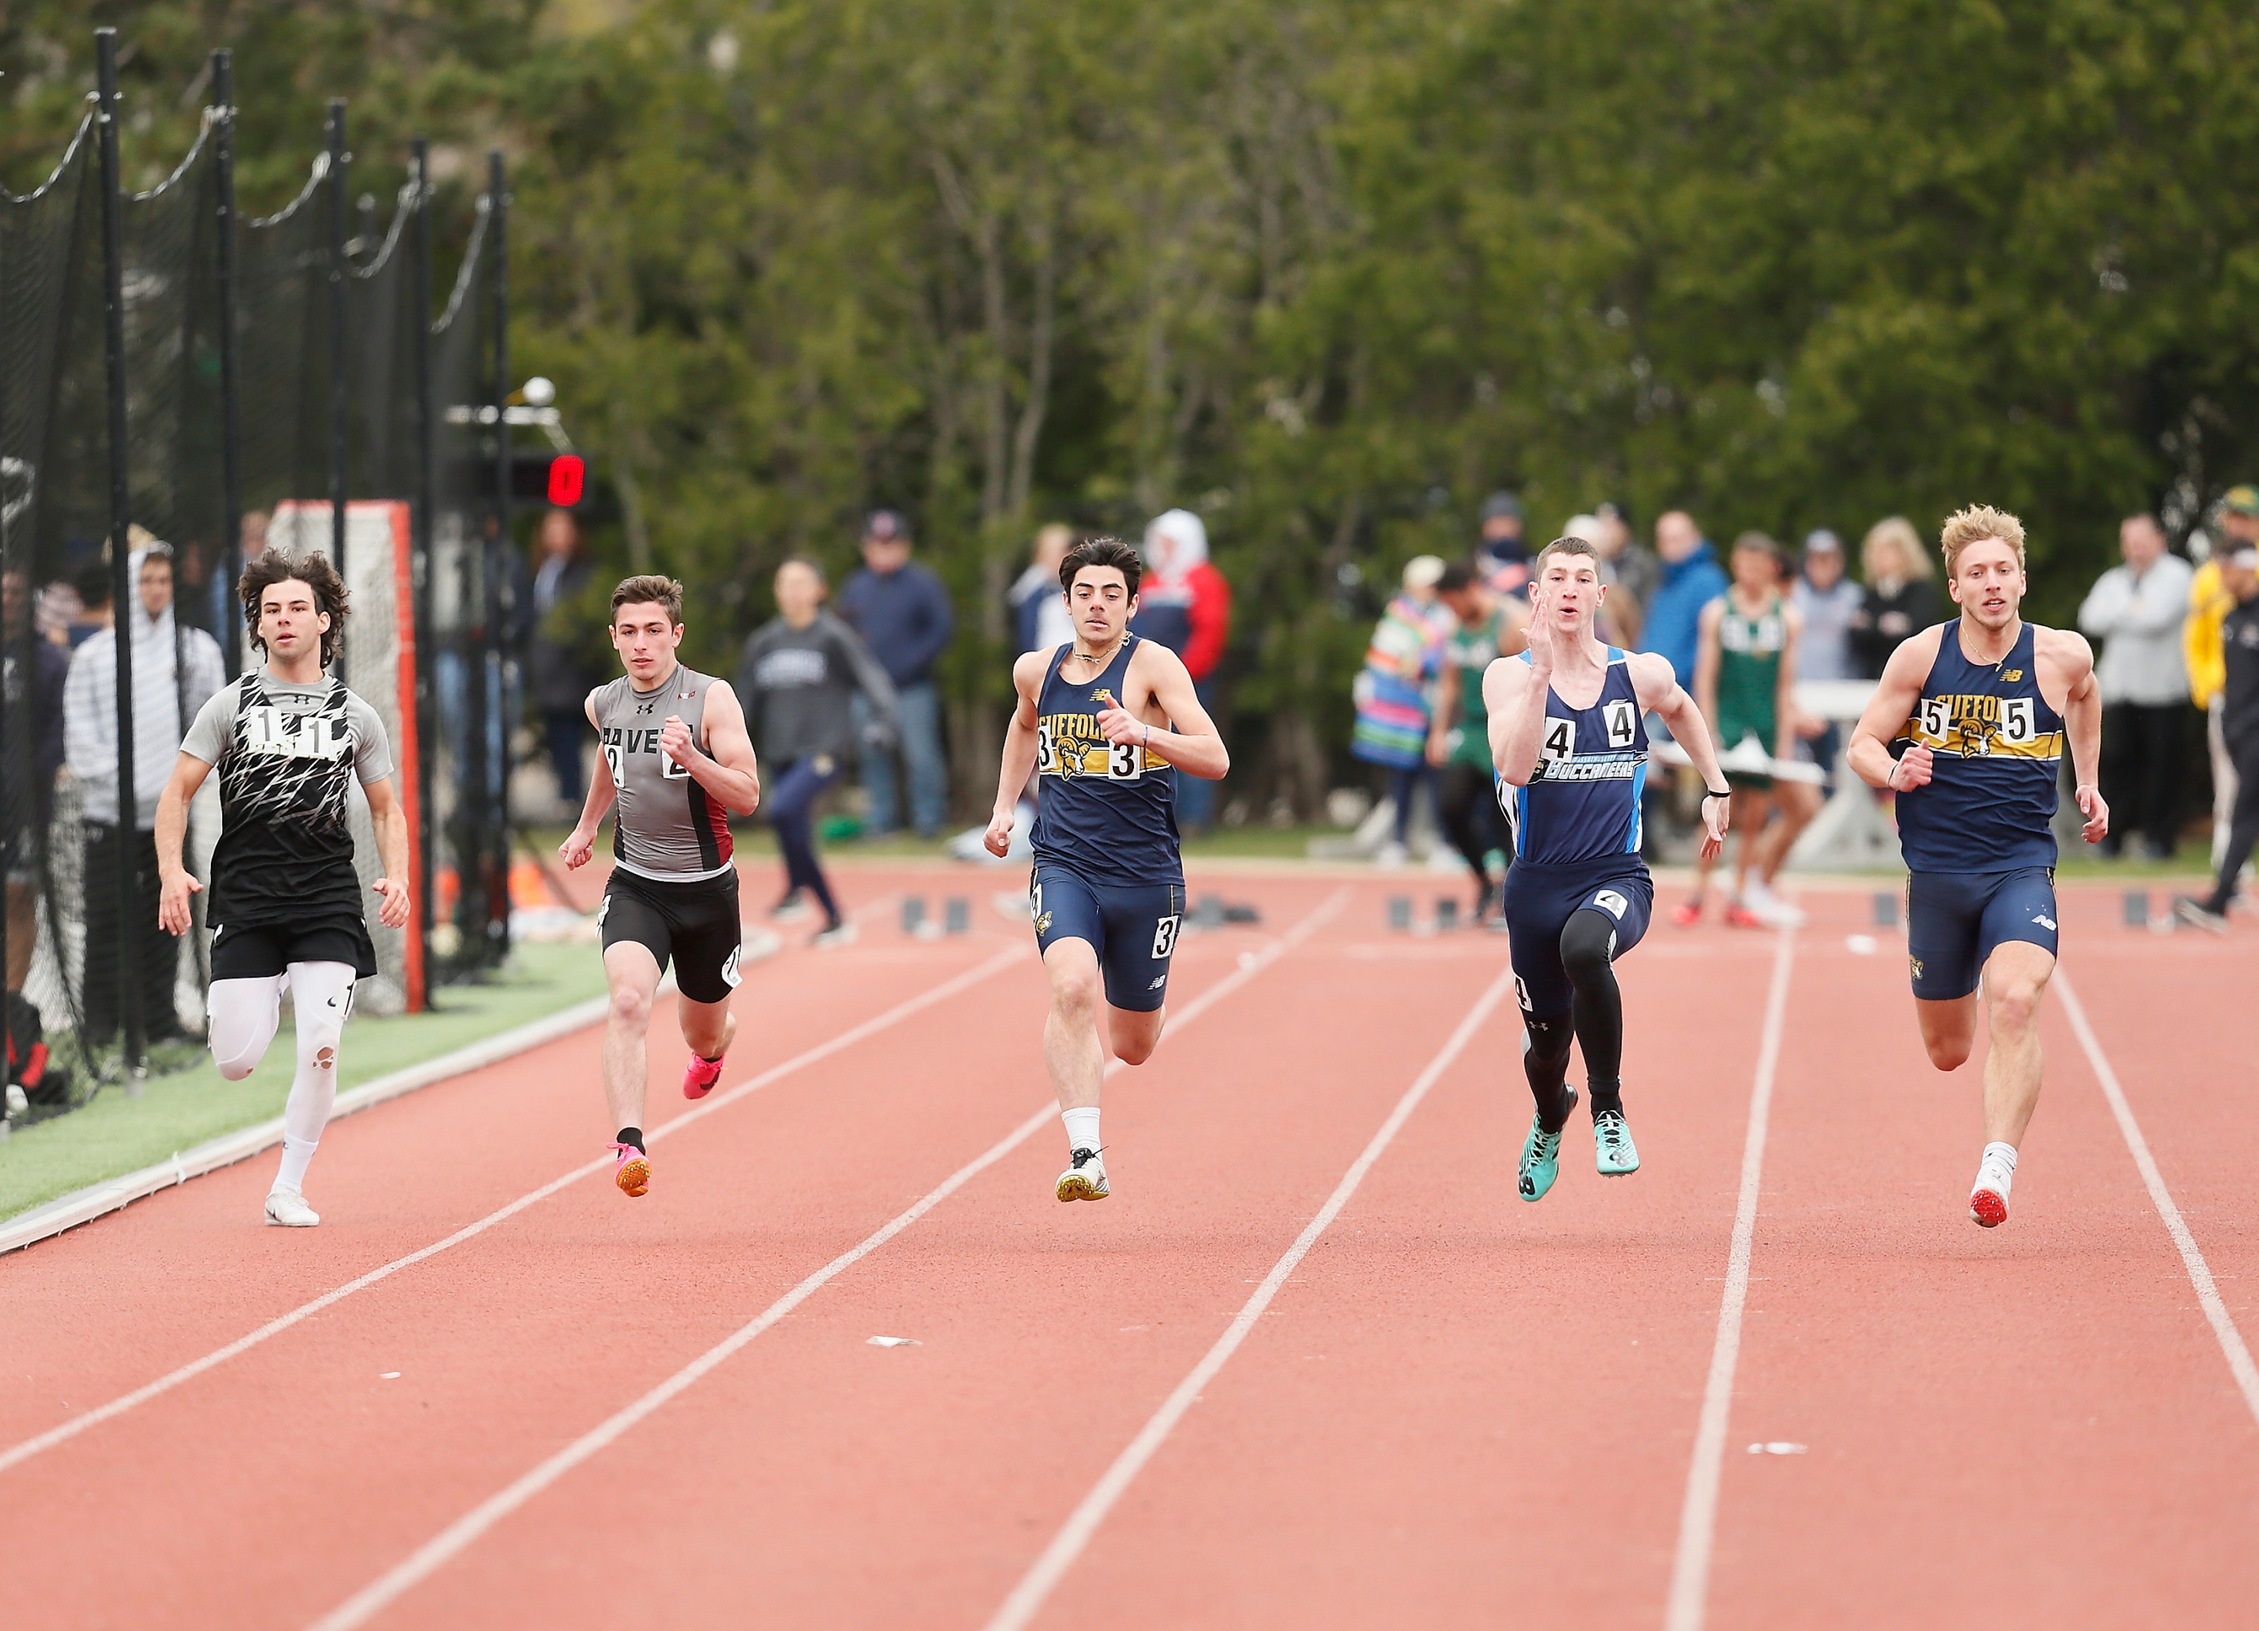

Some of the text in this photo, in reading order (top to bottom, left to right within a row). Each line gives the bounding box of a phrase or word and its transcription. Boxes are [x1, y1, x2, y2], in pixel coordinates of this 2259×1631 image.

[548, 455, 585, 506] 0
[1999, 669, 2023, 683] NB
[258, 709, 271, 742] 1
[1039, 713, 1106, 742] UFFOL
[1612, 706, 1632, 742] 4
[1926, 701, 1943, 735] 5
[2007, 702, 2026, 740] 5
[308, 720, 320, 753] 1
[1039, 730, 1050, 767] 3
[1546, 722, 1568, 759] 4
[1112, 743, 1135, 777] 3
[1599, 893, 1621, 912] 4
[1156, 920, 1174, 956] 3
